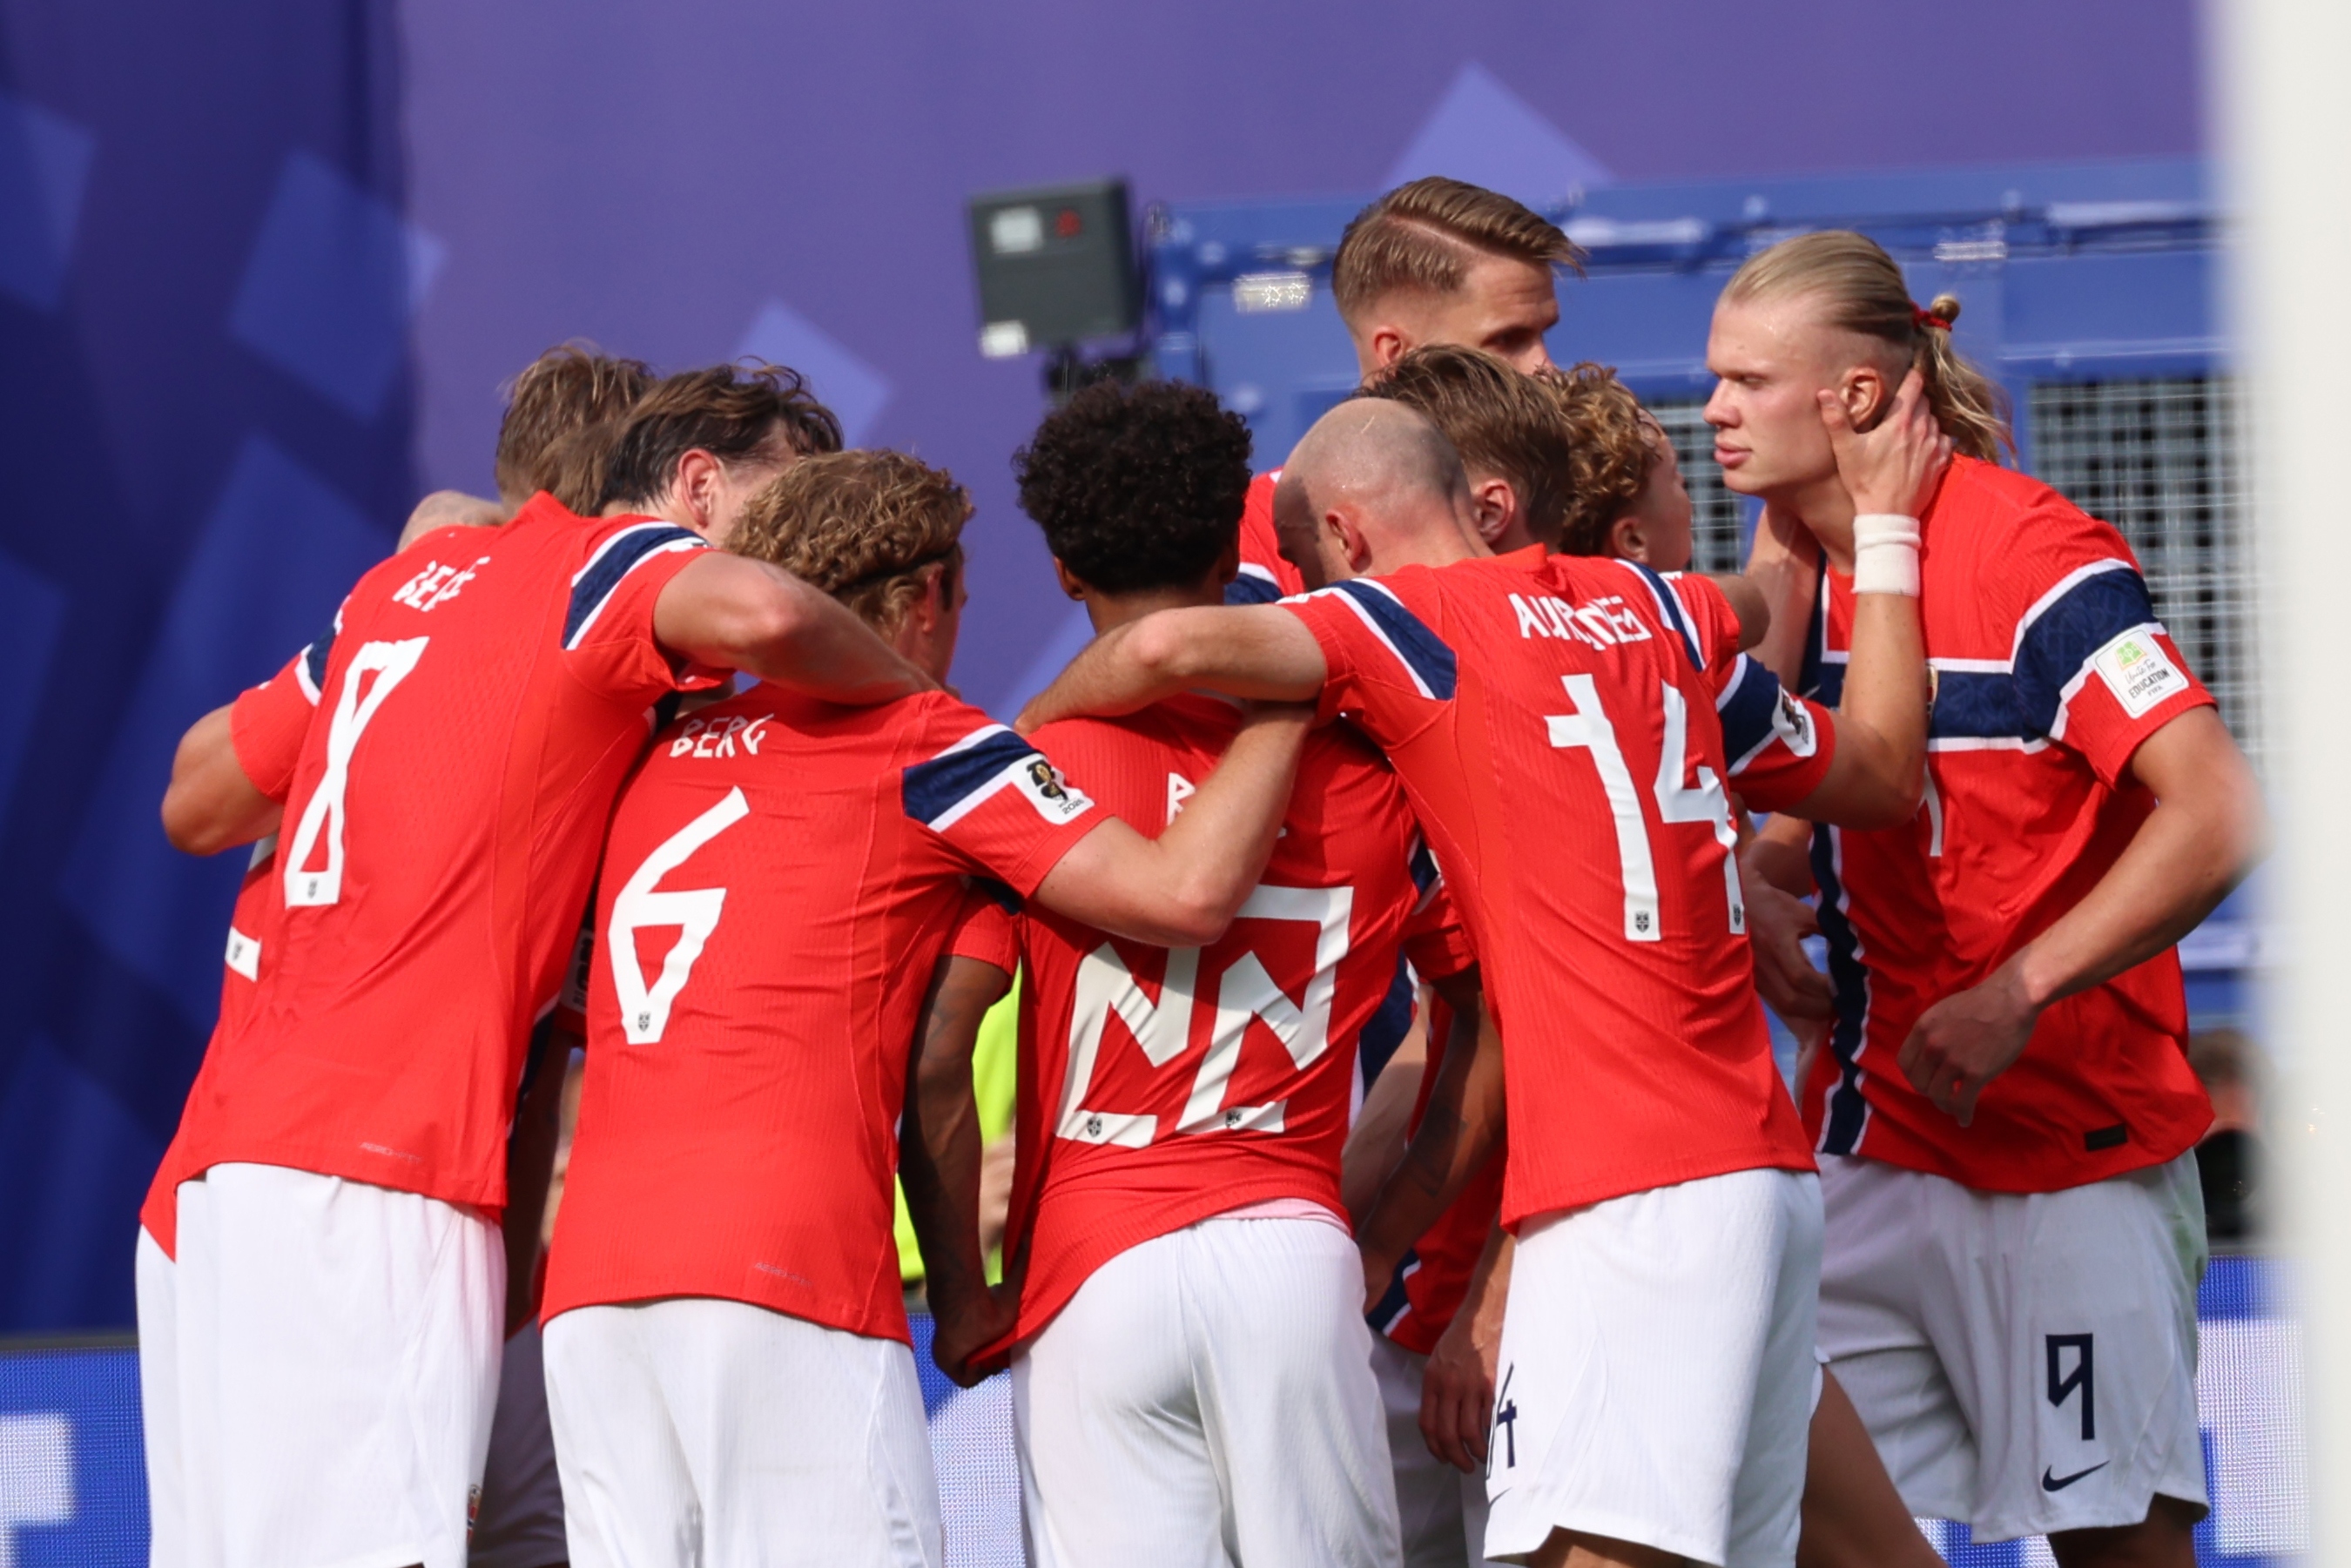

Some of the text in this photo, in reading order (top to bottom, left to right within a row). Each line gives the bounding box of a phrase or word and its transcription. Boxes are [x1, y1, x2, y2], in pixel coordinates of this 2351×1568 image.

[283, 636, 430, 908] 8
[669, 712, 773, 757] BERG
[2128, 669, 2170, 698] EDUCATION
[1545, 673, 1747, 942] 14
[608, 787, 748, 1045] 6
[1054, 885, 1352, 1147] 22
[1485, 1361, 1518, 1478] 4
[2046, 1334, 2093, 1441] 9
